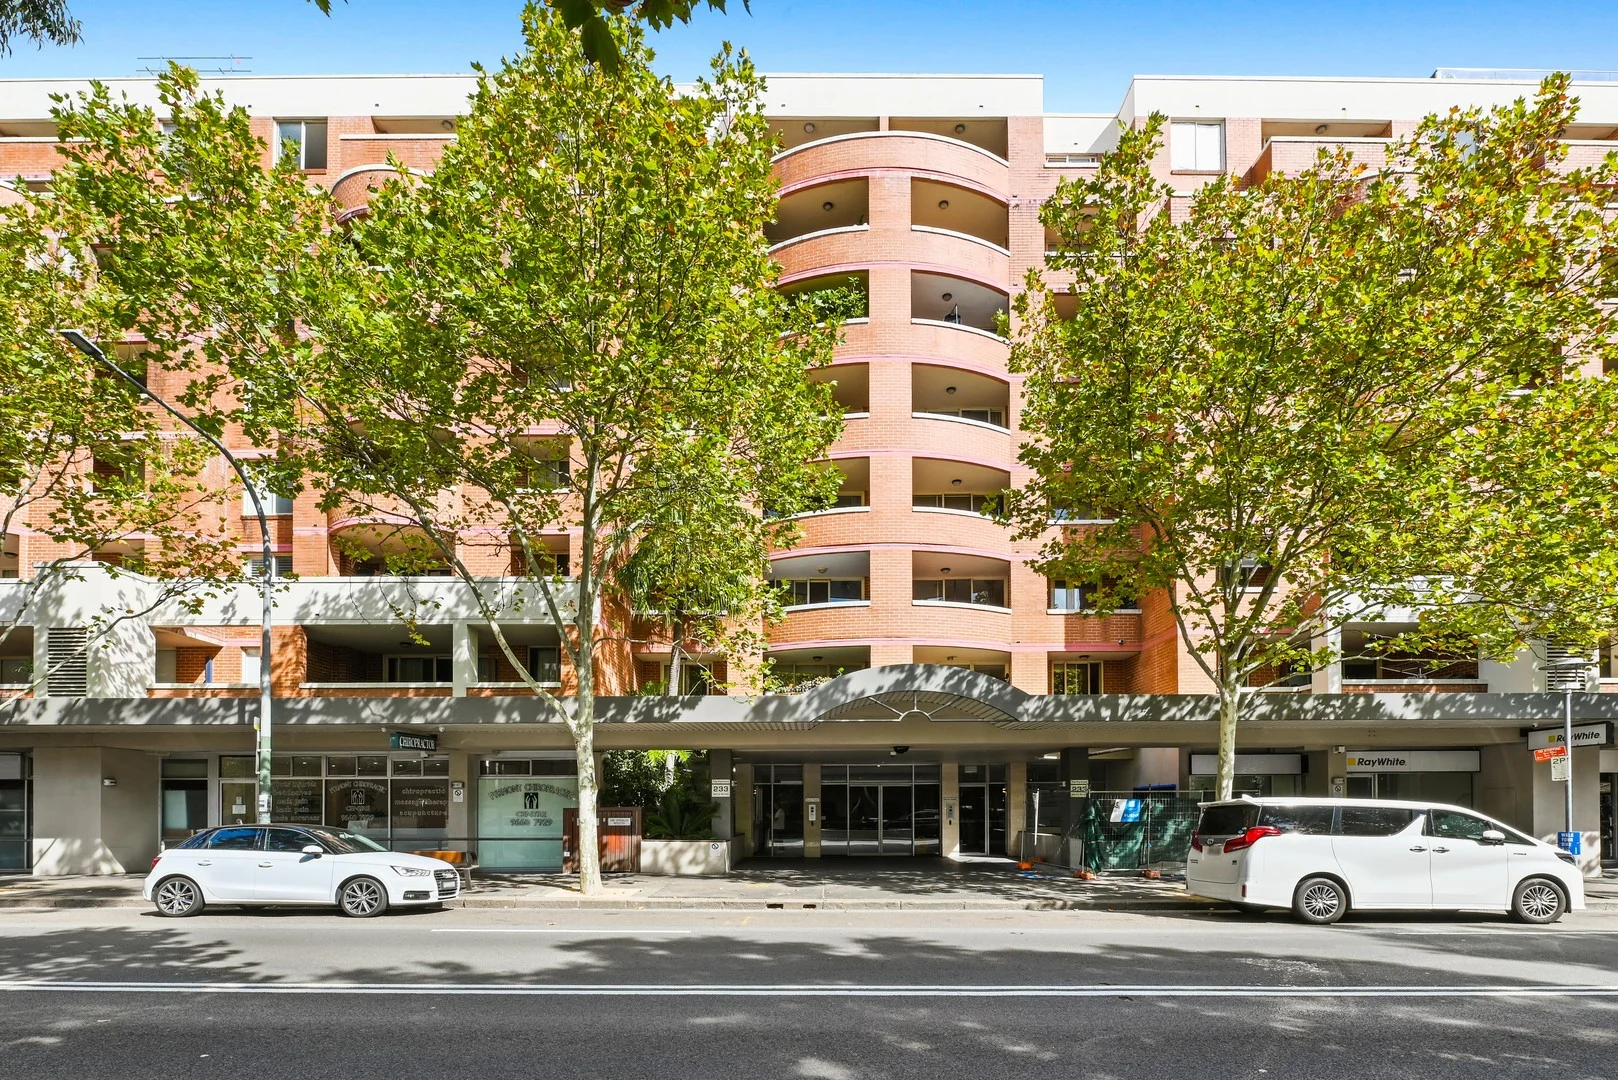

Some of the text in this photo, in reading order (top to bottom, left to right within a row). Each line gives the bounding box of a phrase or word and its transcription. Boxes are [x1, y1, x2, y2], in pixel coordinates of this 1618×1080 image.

[399, 736, 436, 750] CHIROPRACTOR
[1357, 757, 1406, 768] RayWhite
[713, 785, 729, 793] 233
